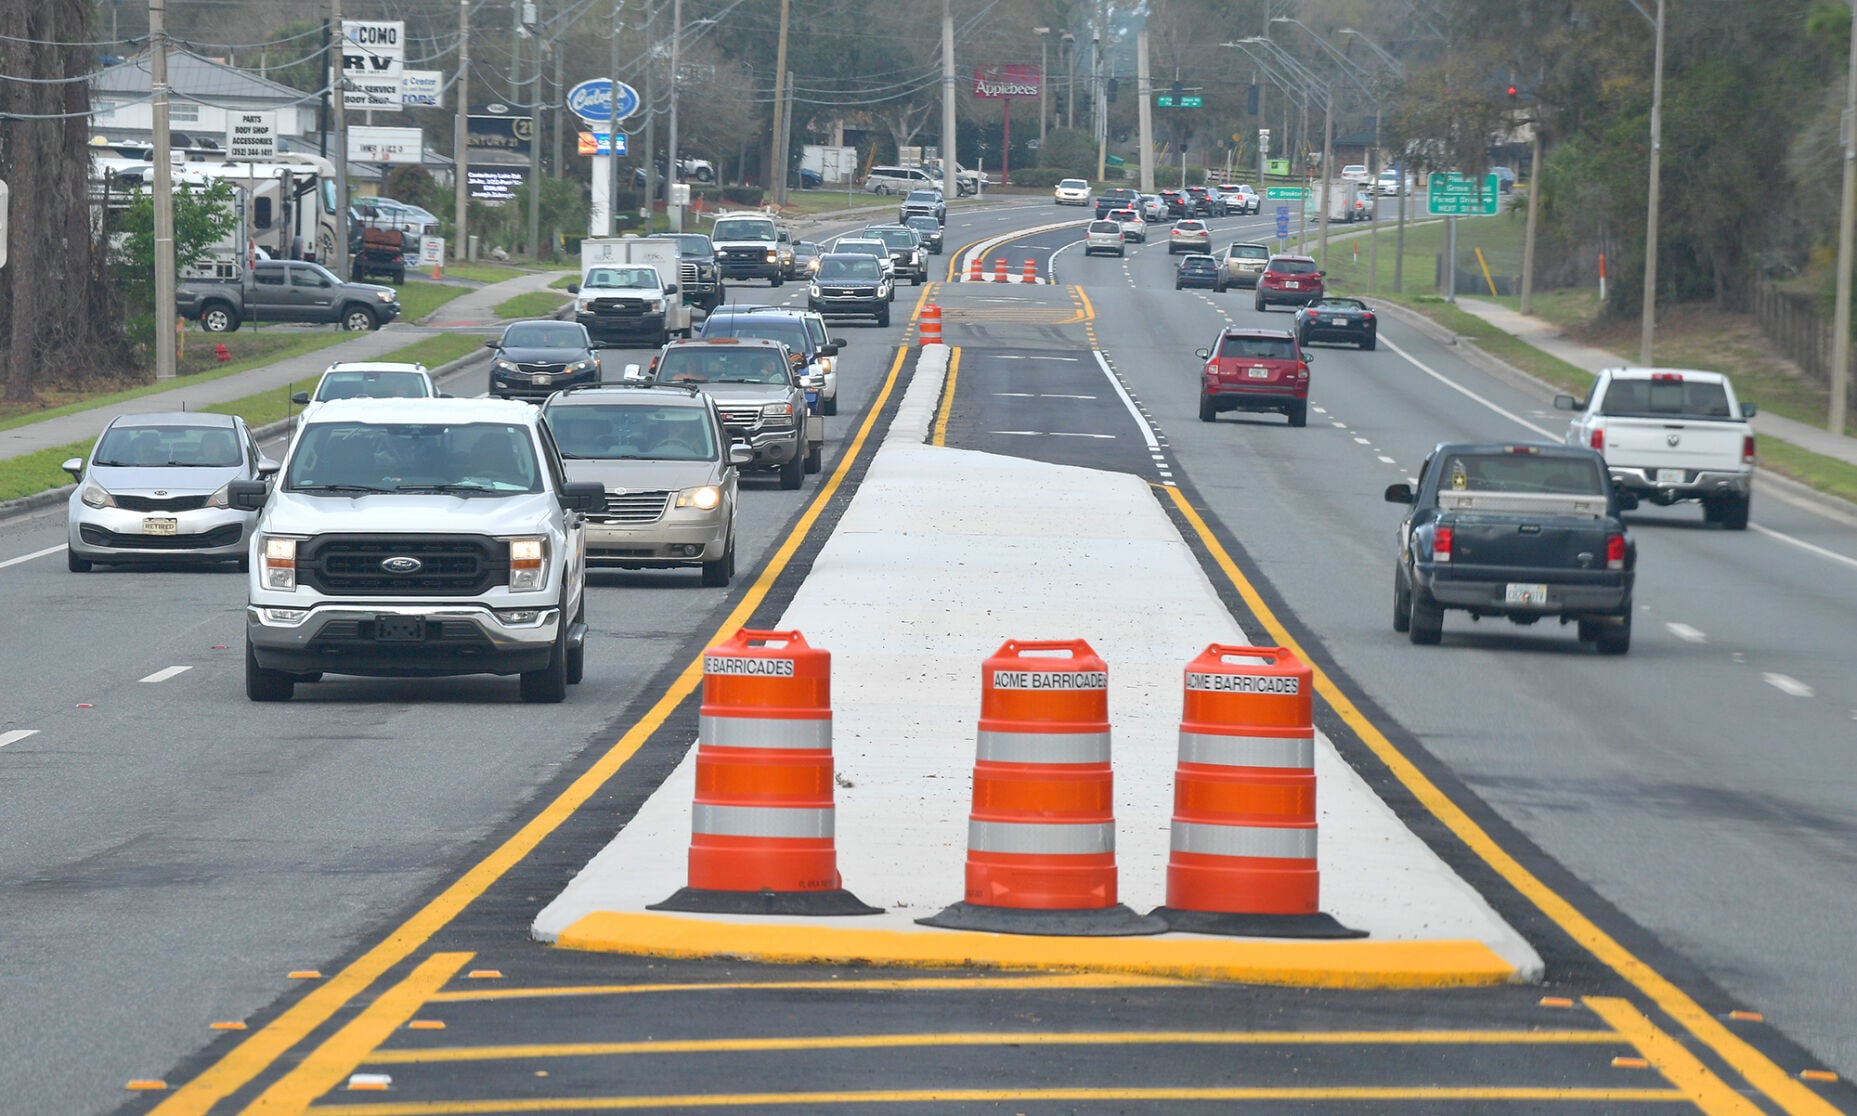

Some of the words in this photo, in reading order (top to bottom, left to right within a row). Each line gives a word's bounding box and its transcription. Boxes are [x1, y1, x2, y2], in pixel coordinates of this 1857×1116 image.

[359, 27, 397, 45] COMO
[343, 55, 393, 70] RV
[365, 86, 397, 94] SERVICE
[242, 115, 262, 123] PARTS
[235, 126, 251, 135] BODY
[252, 126, 269, 135] SHOP
[232, 137, 273, 146] ACCESSORIES
[712, 658, 793, 676] BARRICADES
[994, 672, 1028, 688] ACME
[1214, 675, 1298, 694] BARRICADES
